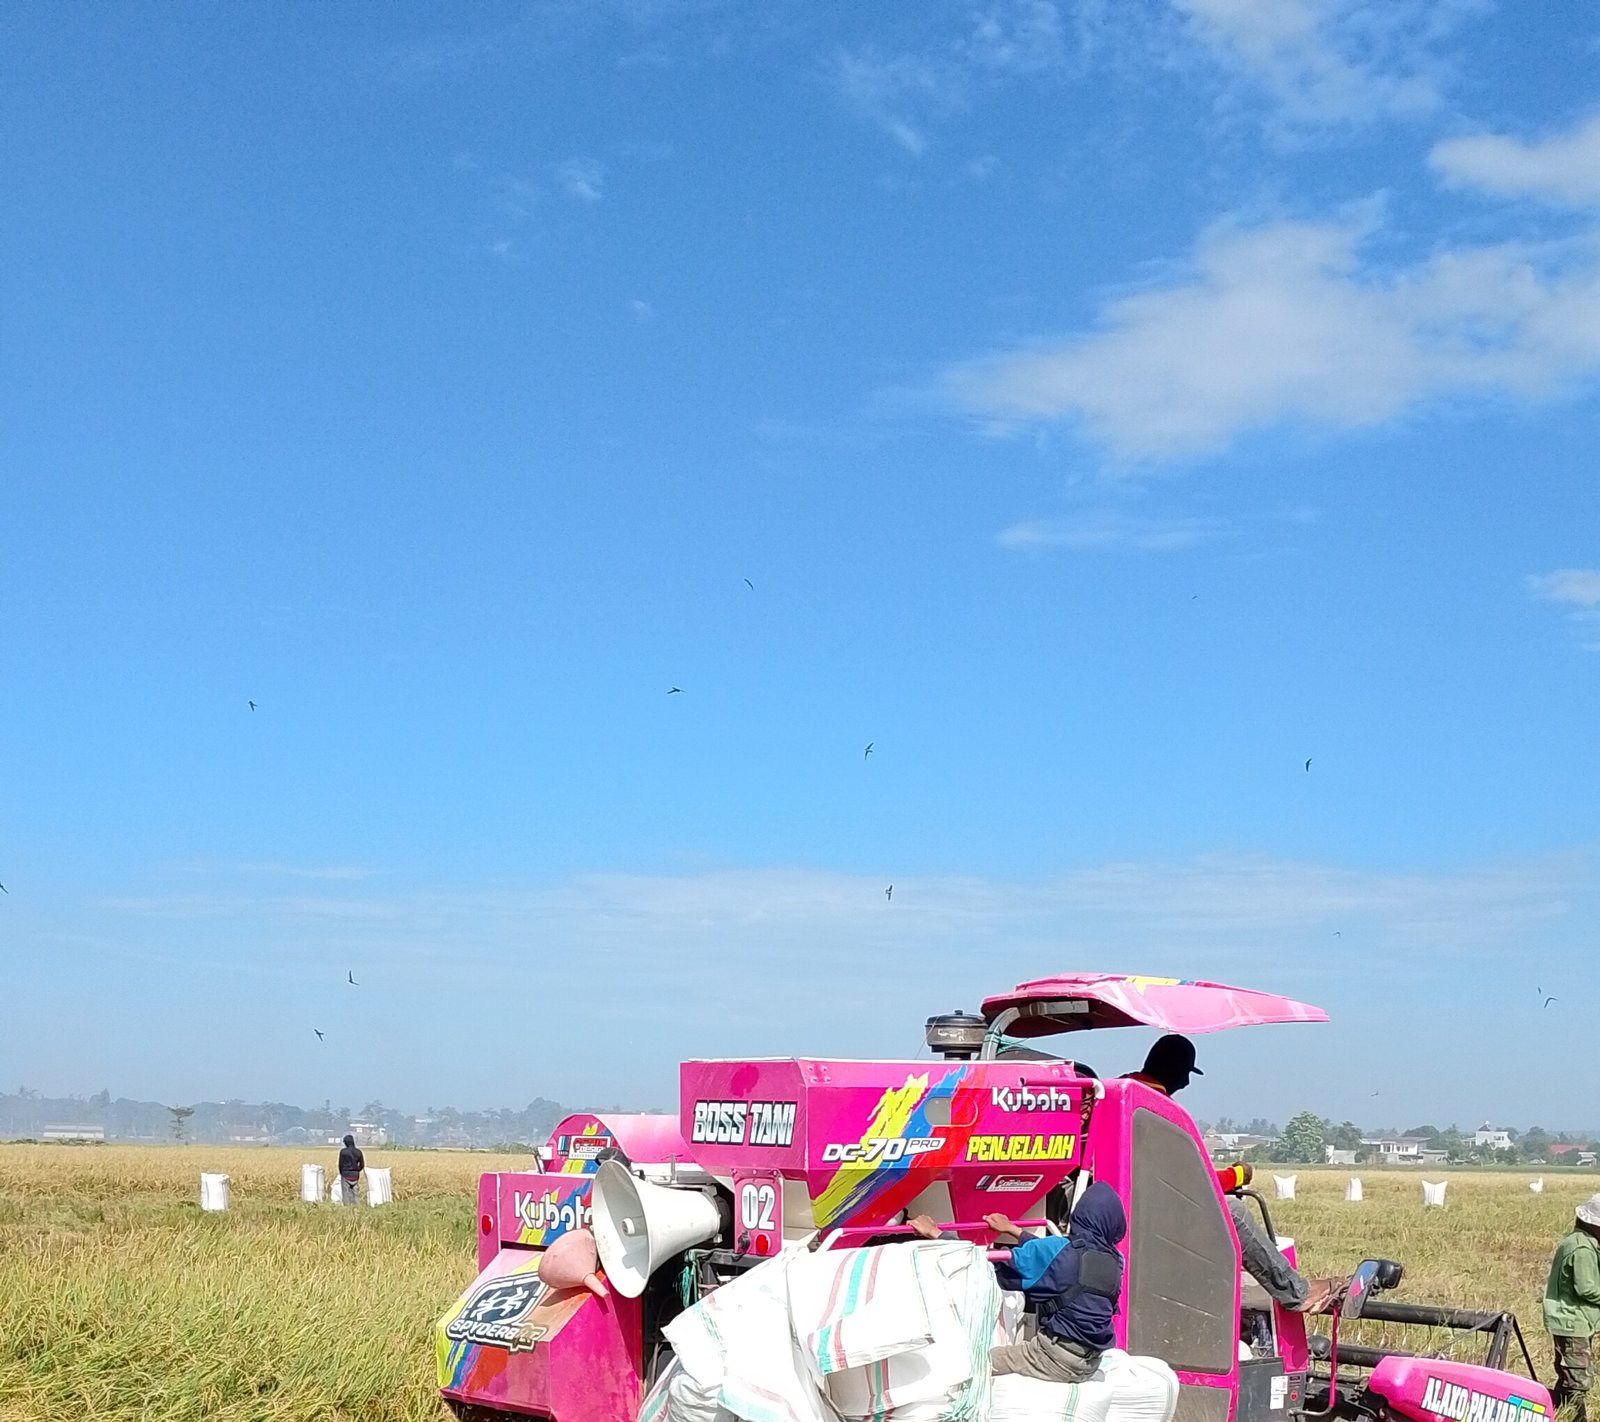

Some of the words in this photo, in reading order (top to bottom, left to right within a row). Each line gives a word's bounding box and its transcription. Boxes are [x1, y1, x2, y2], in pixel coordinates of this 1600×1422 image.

[991, 1086, 1071, 1112] Kubota
[691, 1100, 748, 1145] BOSS
[749, 1101, 797, 1147] TANI
[821, 1138, 907, 1162] DC-70
[909, 1139, 941, 1148] PRO
[965, 1134, 1076, 1161] PENJELAJAH
[741, 1183, 776, 1230] 02
